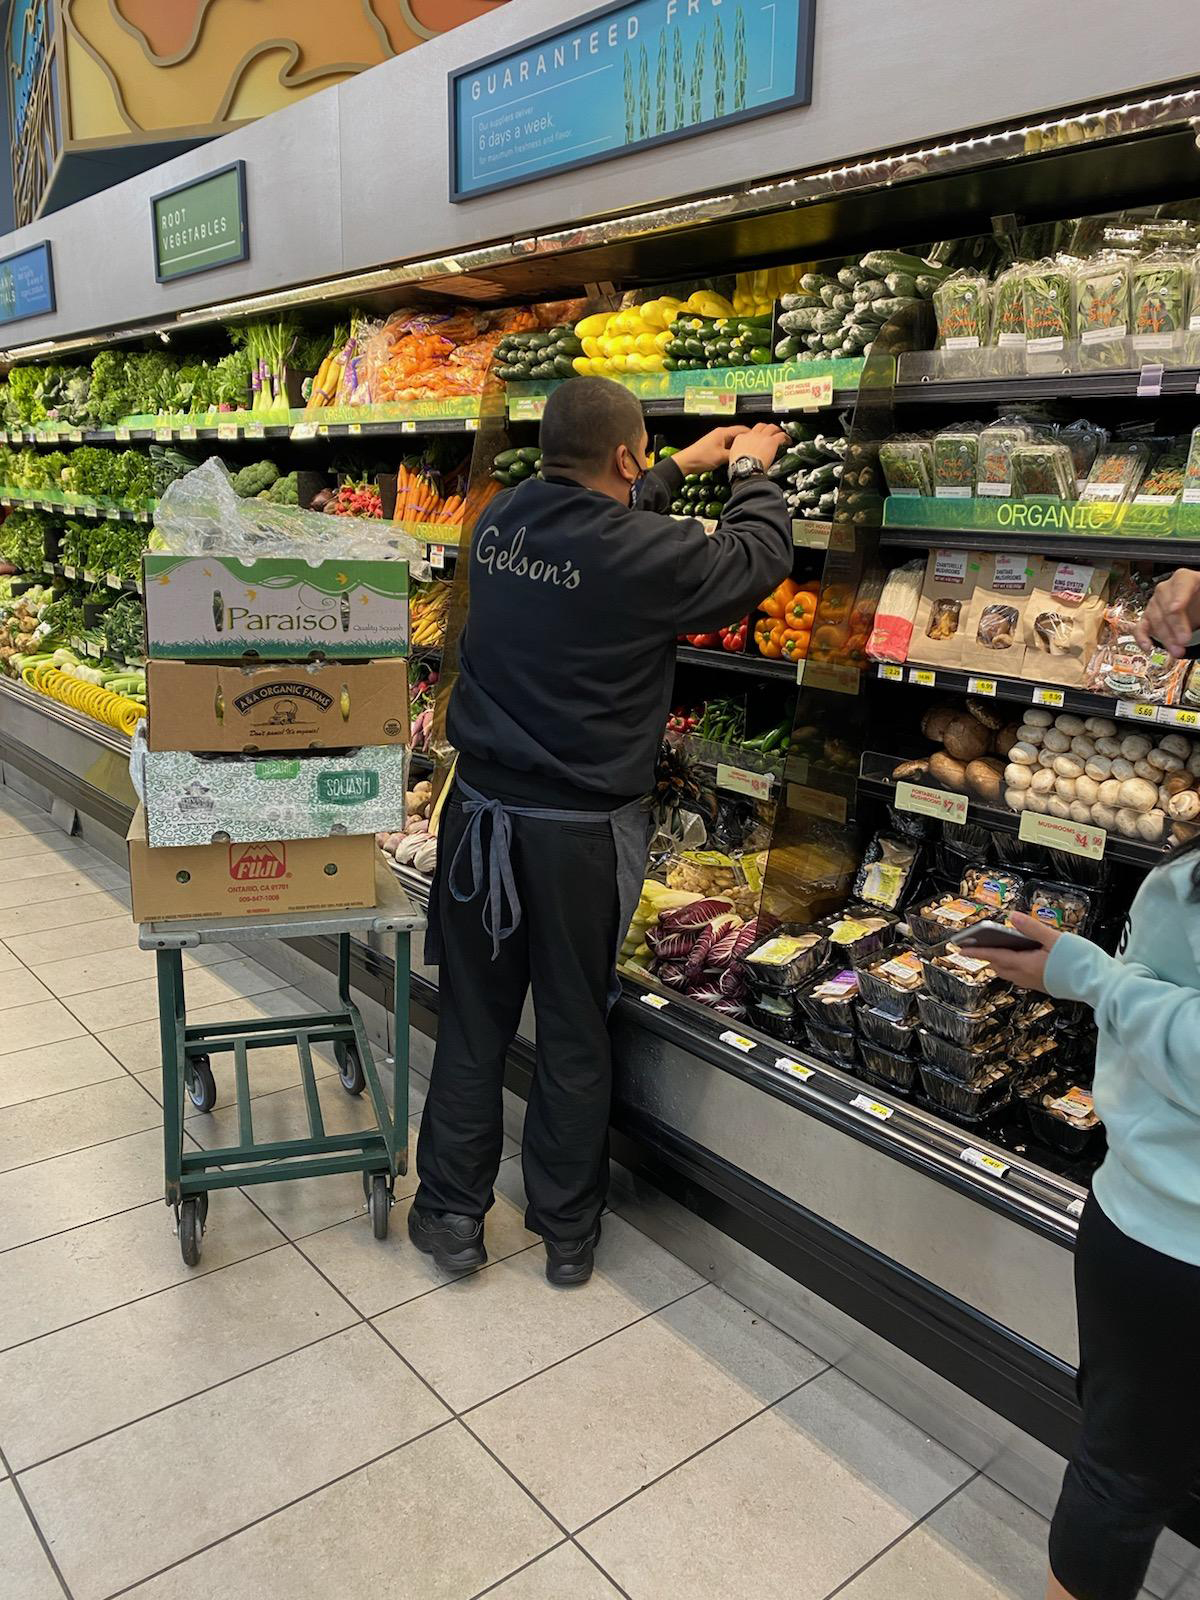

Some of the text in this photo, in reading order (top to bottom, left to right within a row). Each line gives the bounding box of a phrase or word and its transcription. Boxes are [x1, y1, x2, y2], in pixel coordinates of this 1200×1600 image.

[471, 0, 722, 101] GUARANTEED FR
[479, 111, 554, 151] 6 days a week
[161, 208, 186, 230] ROOT
[162, 216, 227, 251] VEGETABLES
[997, 503, 1106, 529] ORGANIC
[476, 525, 581, 590] Gelson's
[227, 605, 337, 632] Paraíso
[353, 623, 403, 633] Quality Squash
[259, 685, 303, 698] ORGANIC
[302, 687, 331, 707] FARMS
[1138, 707, 1153, 717] 5.69
[1179, 714, 1196, 724] 4.99
[326, 778, 371, 797] SQUASH
[1038, 820, 1076, 834] MUSHROOMS
[236, 860, 280, 879] FUJI
[228, 884, 259, 894] ONTARIO,
[260, 884, 270, 892] CA
